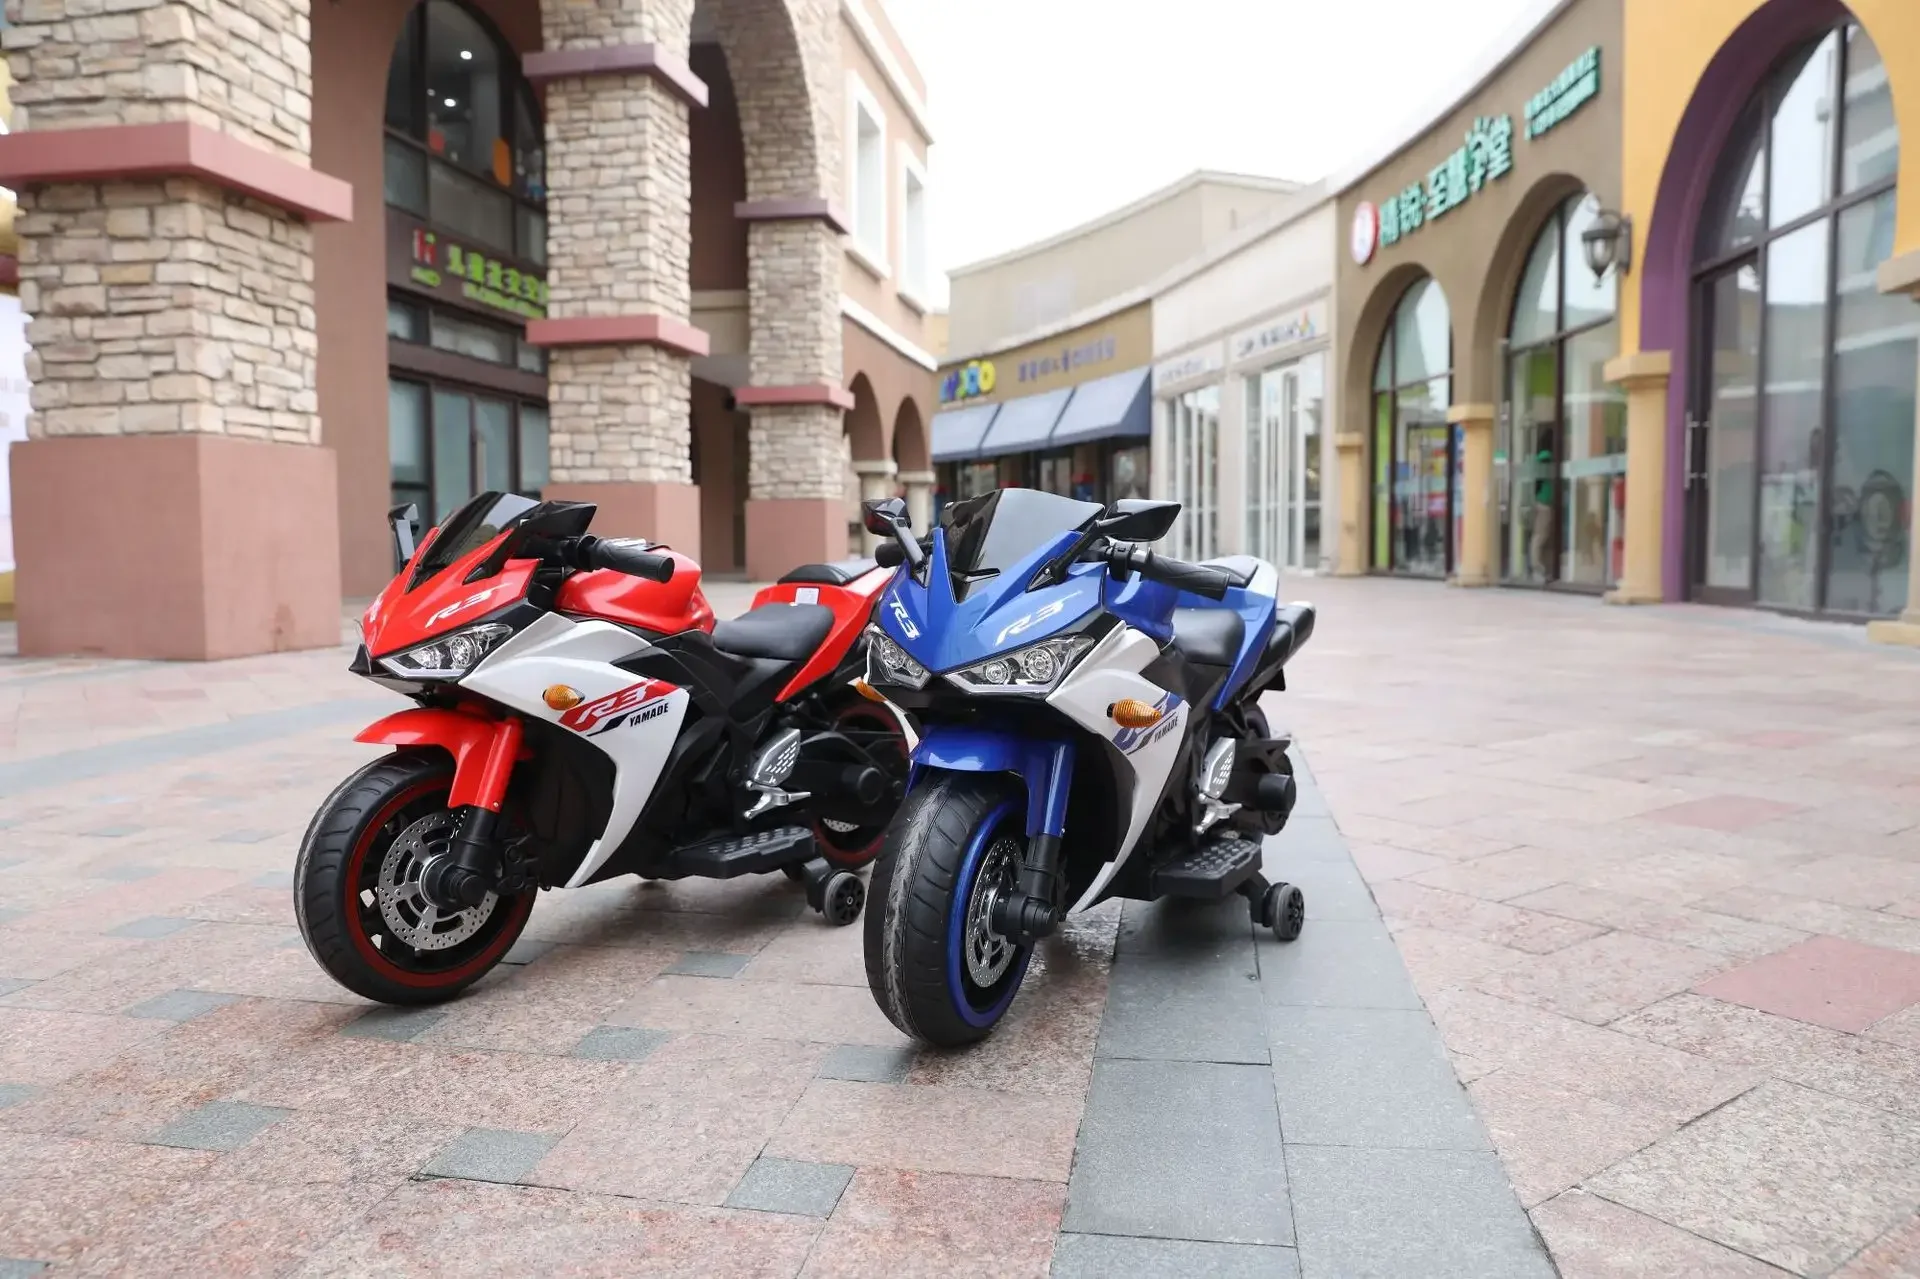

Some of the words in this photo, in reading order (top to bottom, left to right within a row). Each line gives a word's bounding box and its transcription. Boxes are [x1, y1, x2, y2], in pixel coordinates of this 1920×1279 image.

[425, 584, 508, 629] R3
[889, 593, 921, 640] R3
[994, 592, 1078, 647] R3
[574, 681, 656, 725] R3
[629, 702, 669, 728] YAMADE
